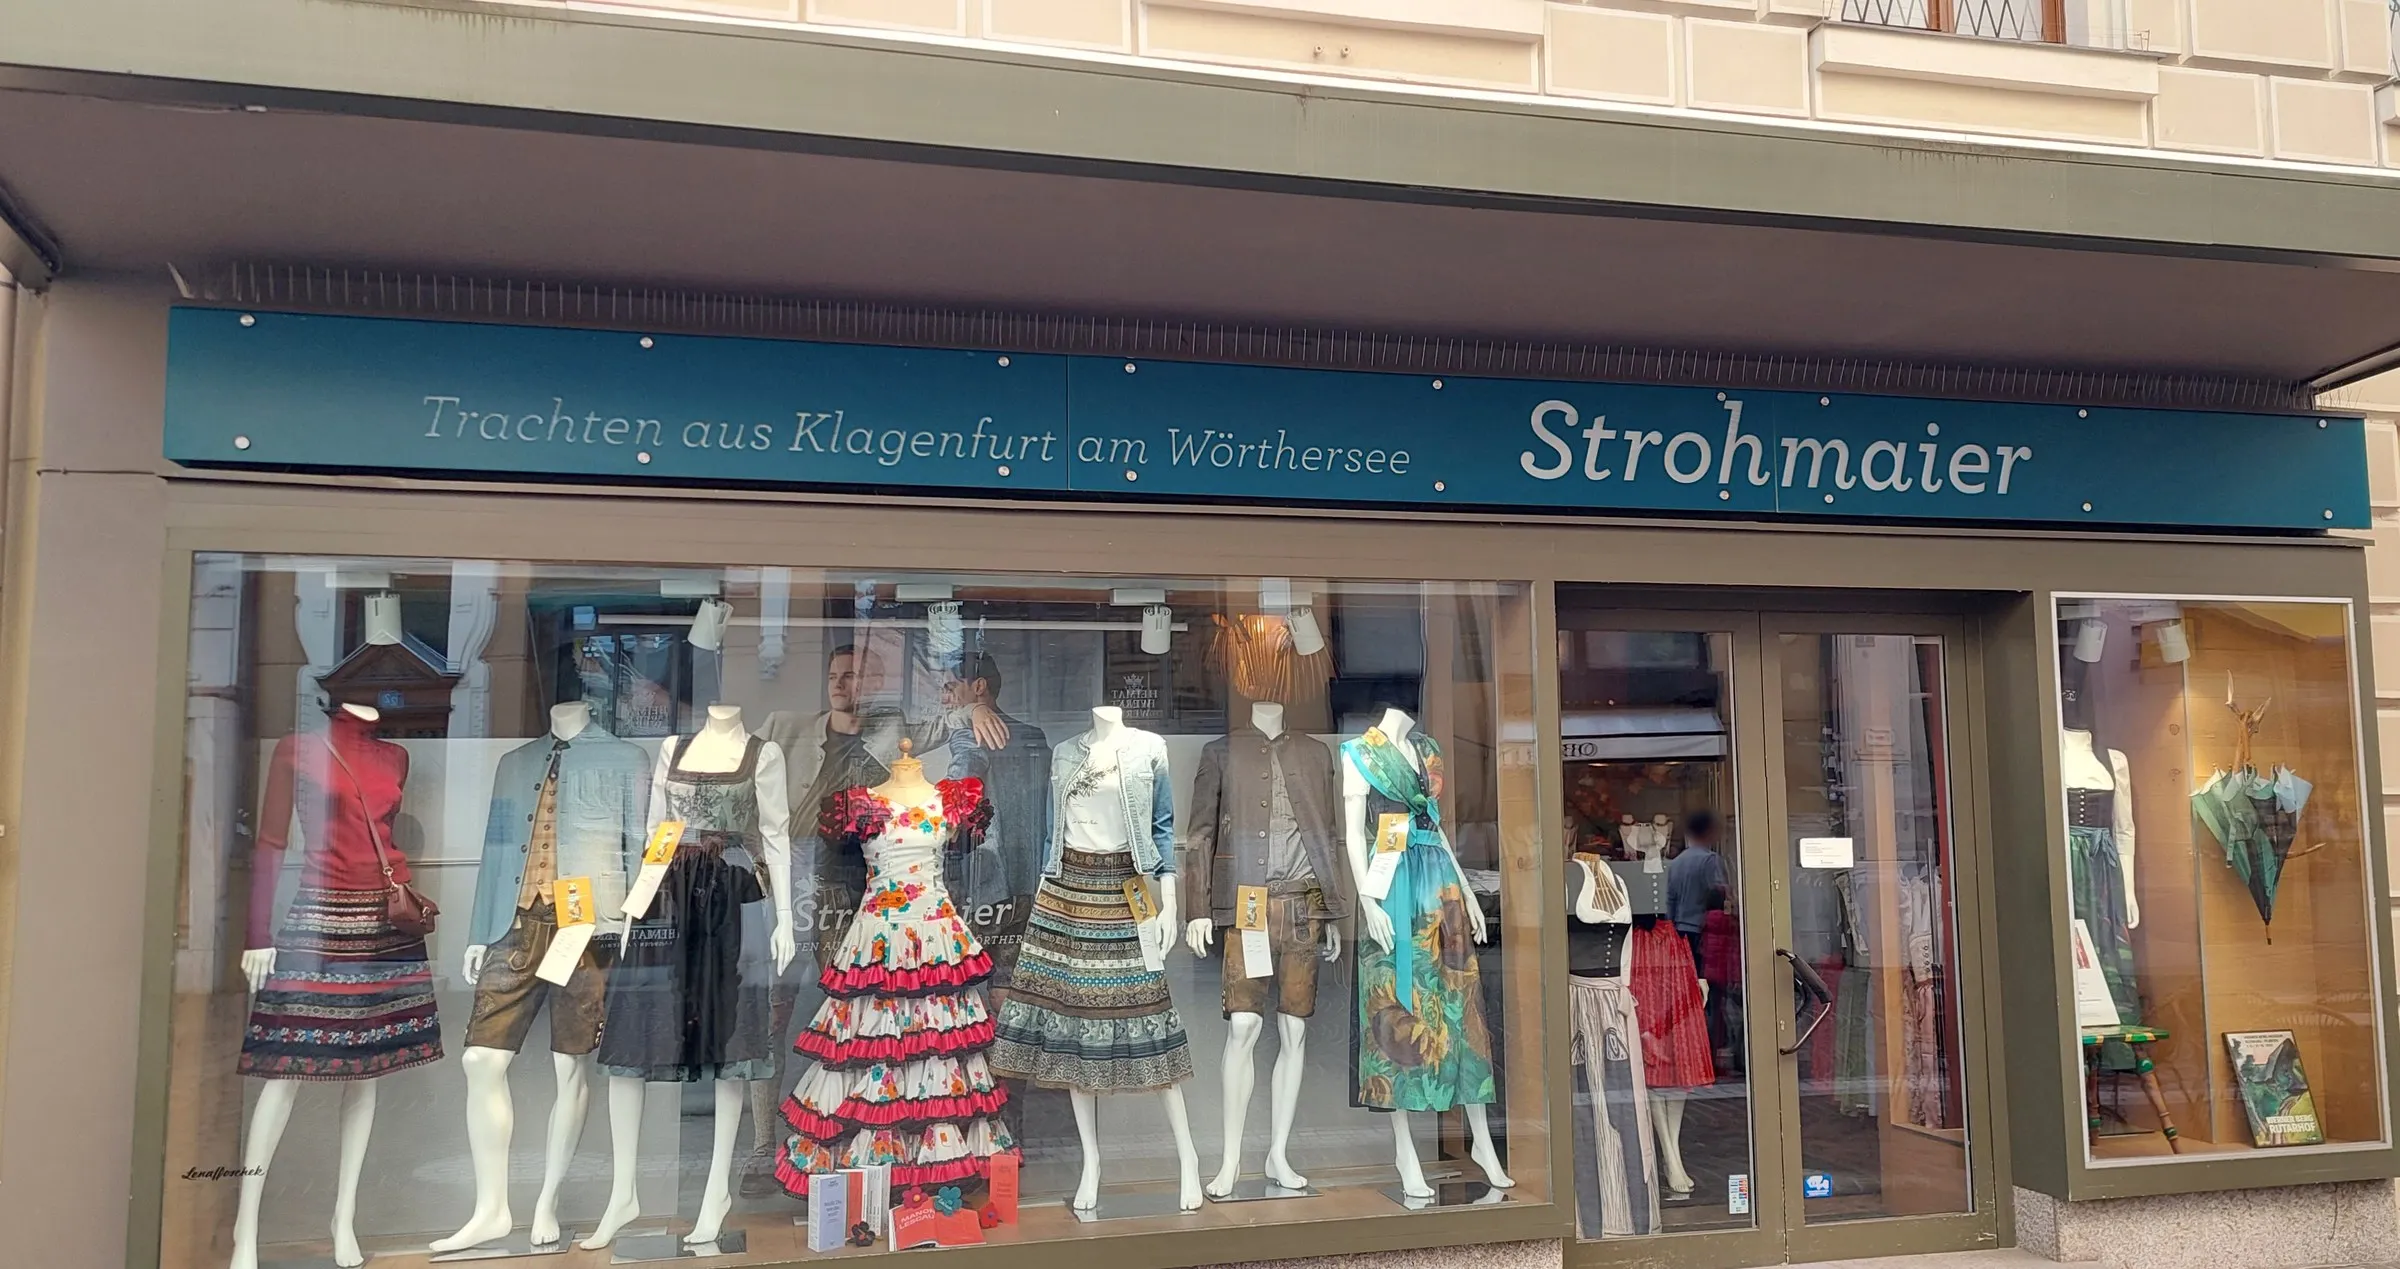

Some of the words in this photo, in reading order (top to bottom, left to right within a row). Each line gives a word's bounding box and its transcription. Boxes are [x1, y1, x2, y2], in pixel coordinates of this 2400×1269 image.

[421, 394, 662, 447] Trachten
[682, 420, 773, 451] aus
[788, 409, 1057, 467] Klagenfurt
[1077, 436, 1149, 465] am
[1167, 427, 1411, 476] Wörthersee
[1519, 399, 2033, 496] Strohmaier
[2268, 1121, 2316, 1133] RUTARHOF
